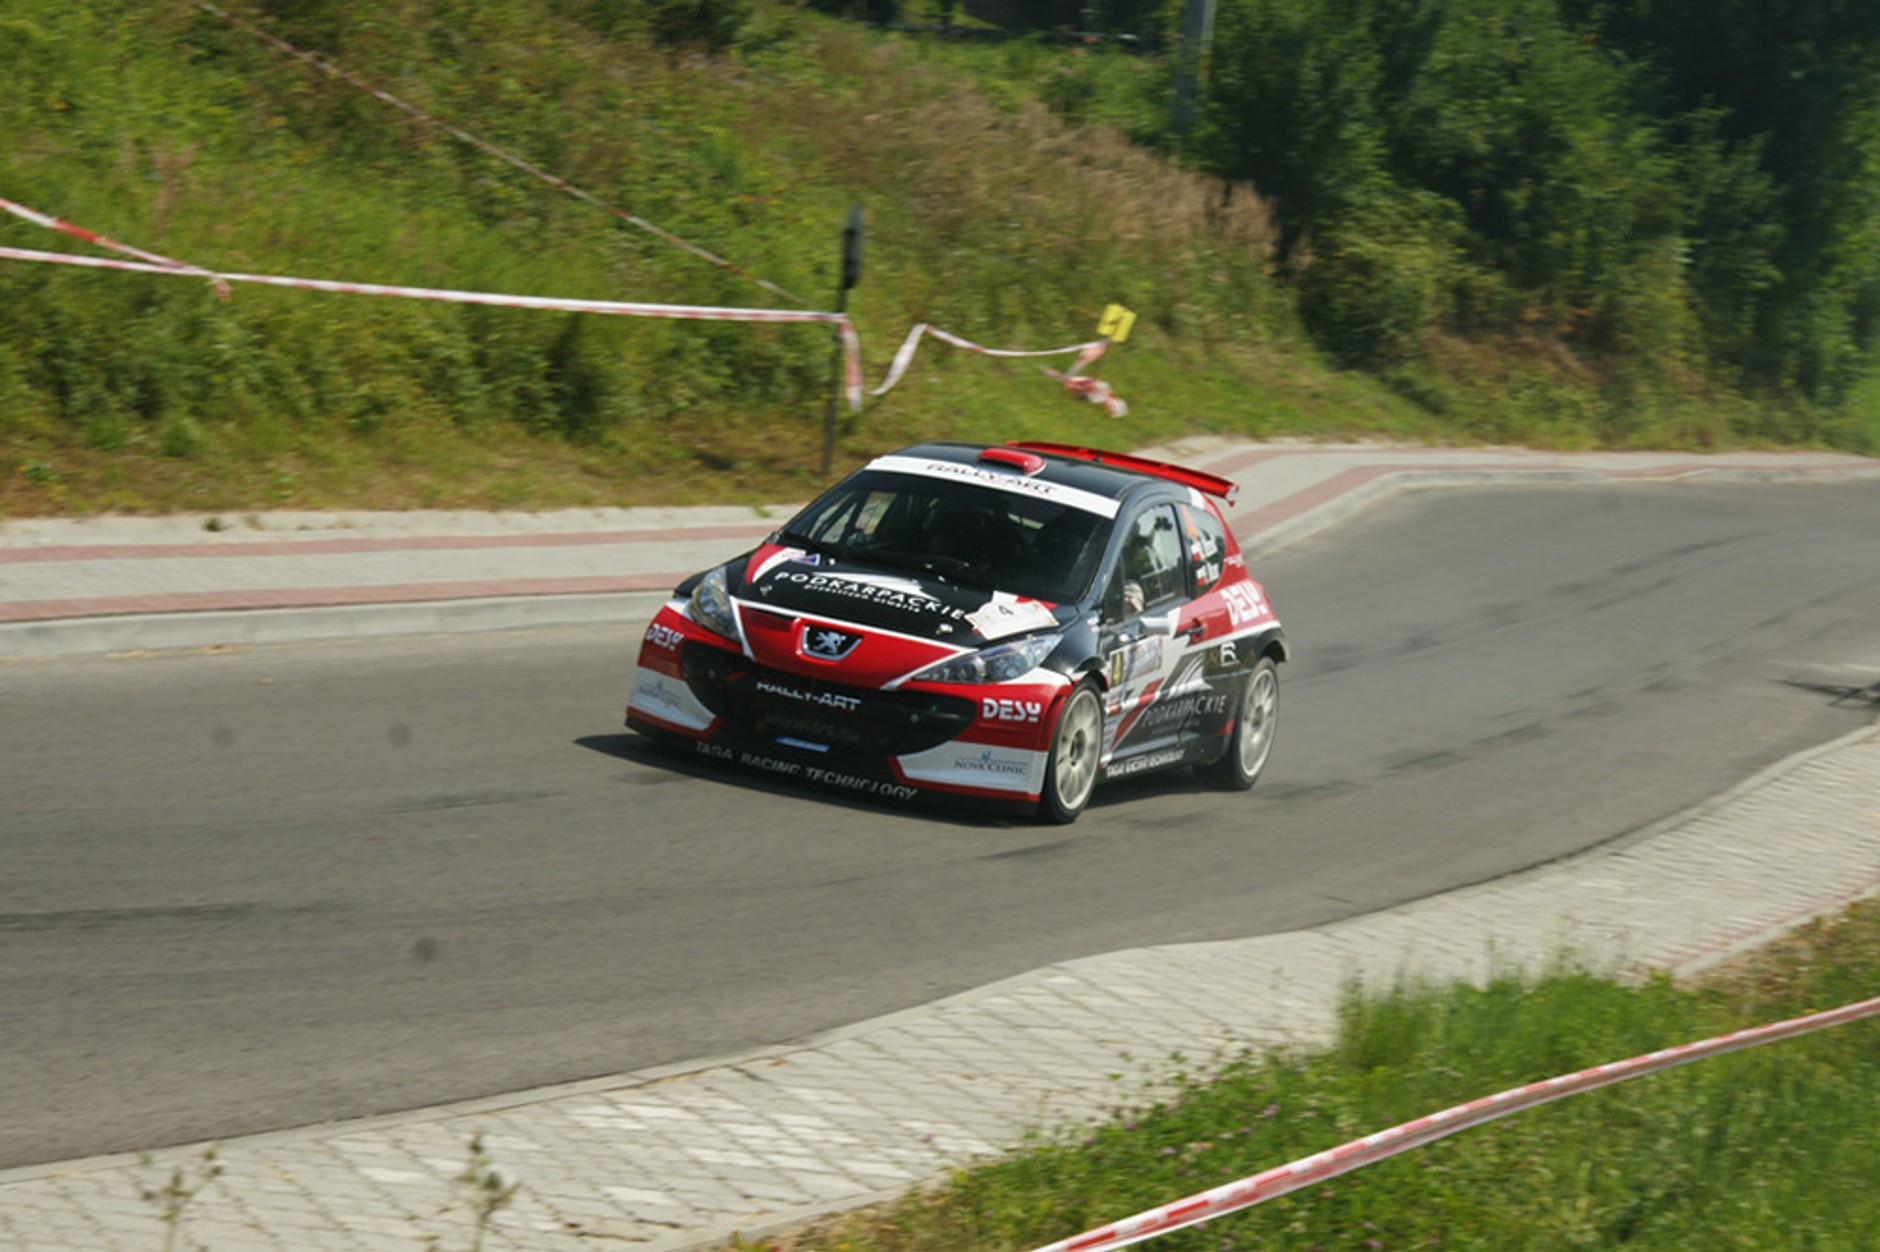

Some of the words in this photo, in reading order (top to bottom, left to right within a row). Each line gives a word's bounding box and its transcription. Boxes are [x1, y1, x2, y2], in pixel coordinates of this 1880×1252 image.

[774, 571, 966, 620] PODKARPACKIE
[954, 760, 984, 771] NOVA
[987, 762, 1027, 775] CLINIC
